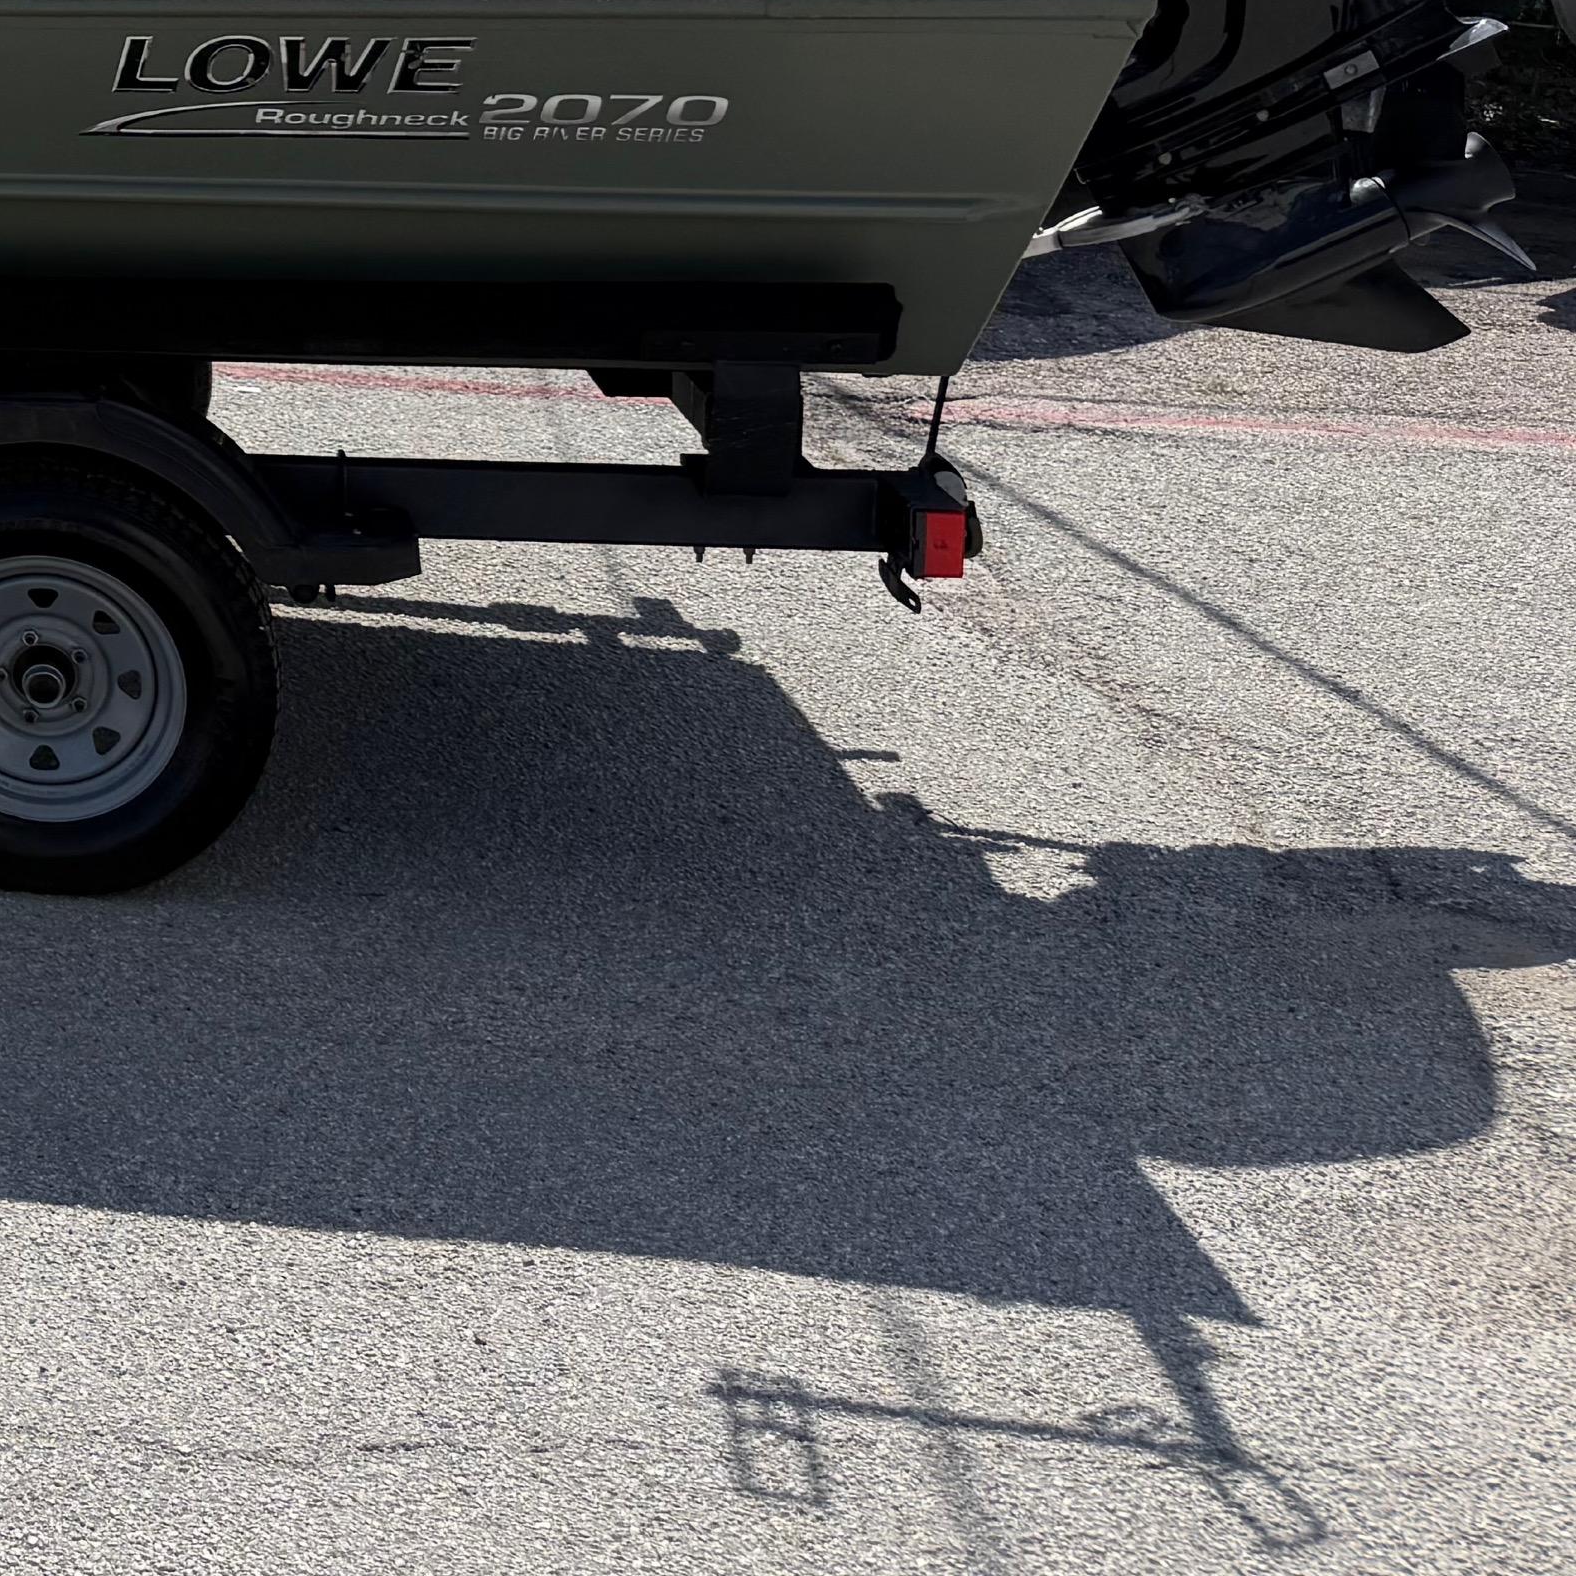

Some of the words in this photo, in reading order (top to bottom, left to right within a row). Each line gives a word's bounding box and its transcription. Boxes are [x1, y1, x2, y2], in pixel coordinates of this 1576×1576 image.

[111, 35, 478, 94] LOWE
[254, 108, 470, 129] Roughneck
[478, 93, 730, 126] 2070
[483, 126, 524, 141] BIG
[615, 127, 705, 143] SERIES
